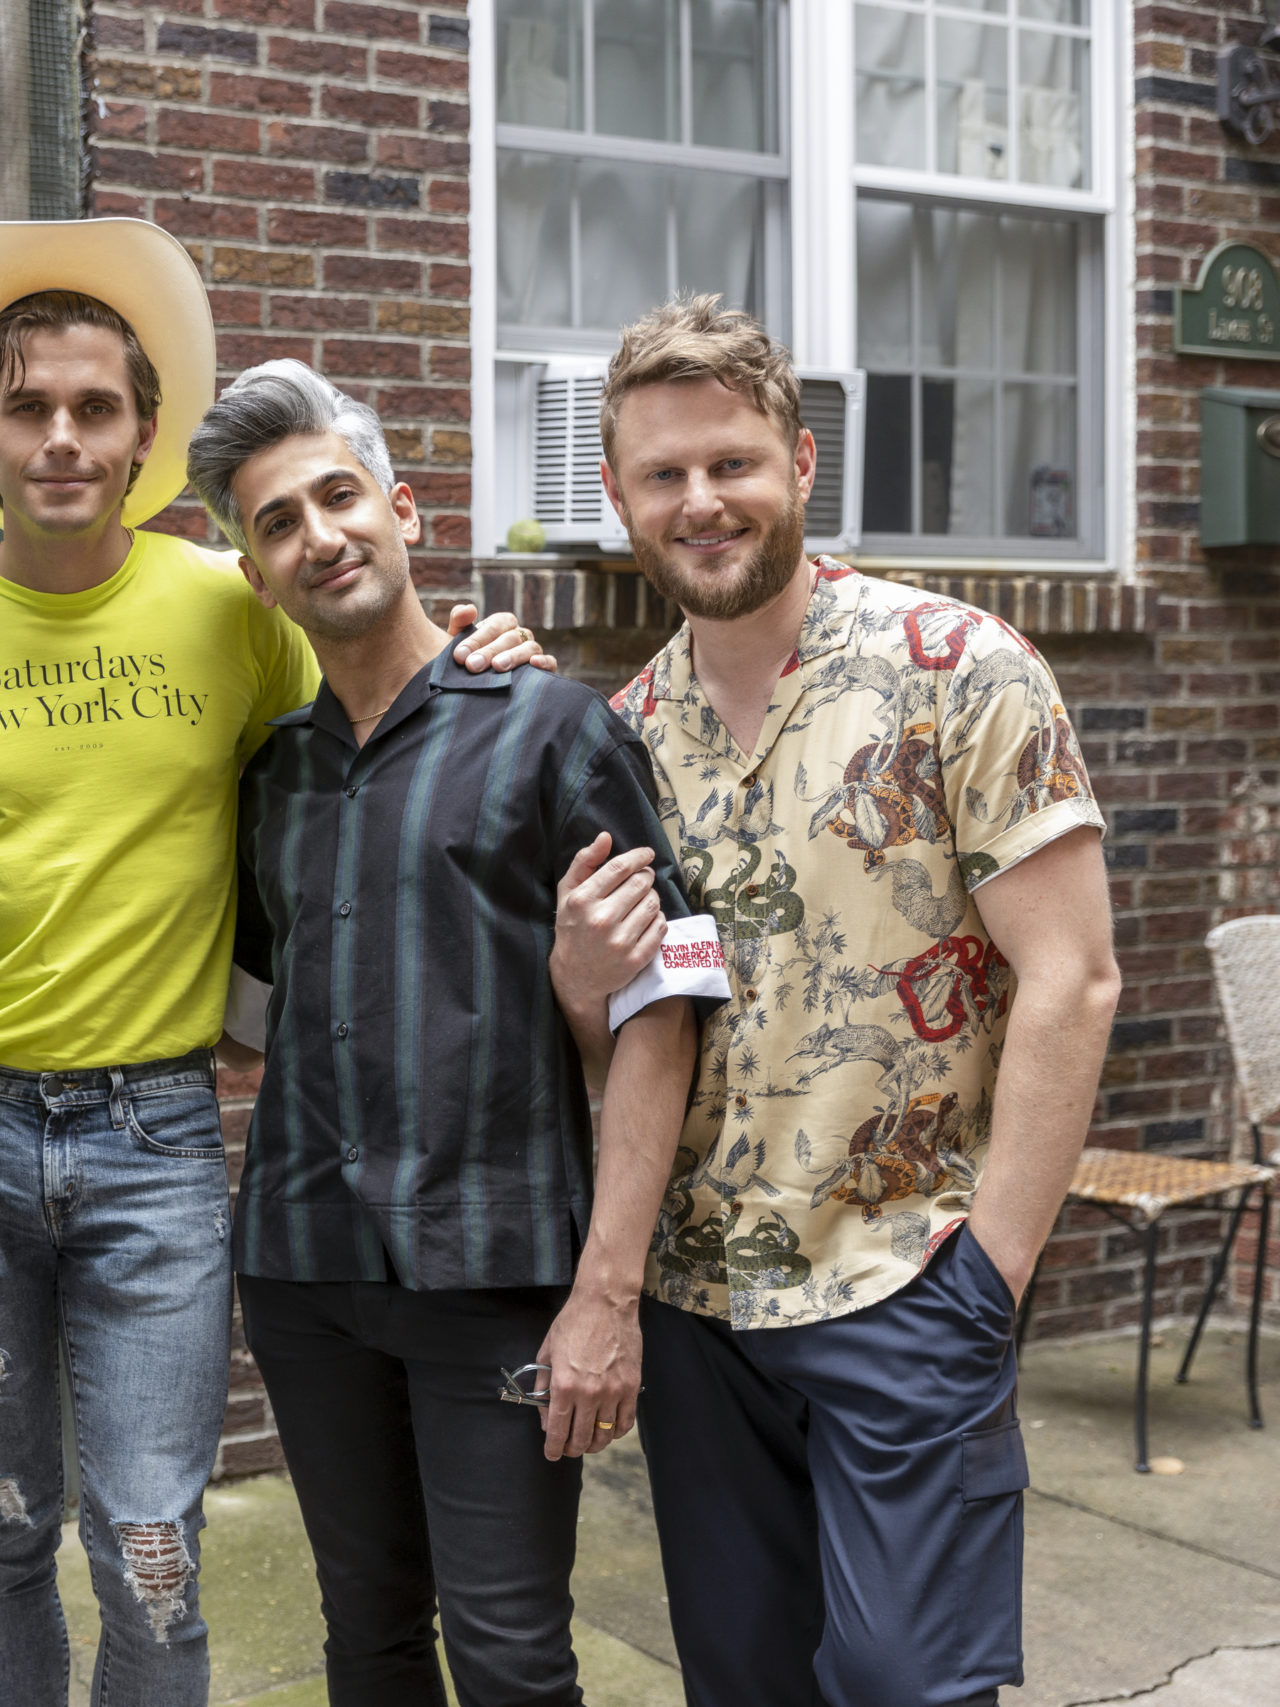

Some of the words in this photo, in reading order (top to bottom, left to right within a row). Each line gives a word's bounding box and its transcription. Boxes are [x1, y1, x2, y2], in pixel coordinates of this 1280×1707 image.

[1221, 264, 1263, 310] 908
[35, 686, 125, 728] York
[131, 684, 209, 726] City
[660, 944, 689, 953] CALVIN
[691, 941, 715, 951] KLEIN
[662, 952, 672, 961] IN
[673, 950, 711, 961] AMERICA
[664, 959, 712, 969] CONCEIVED
